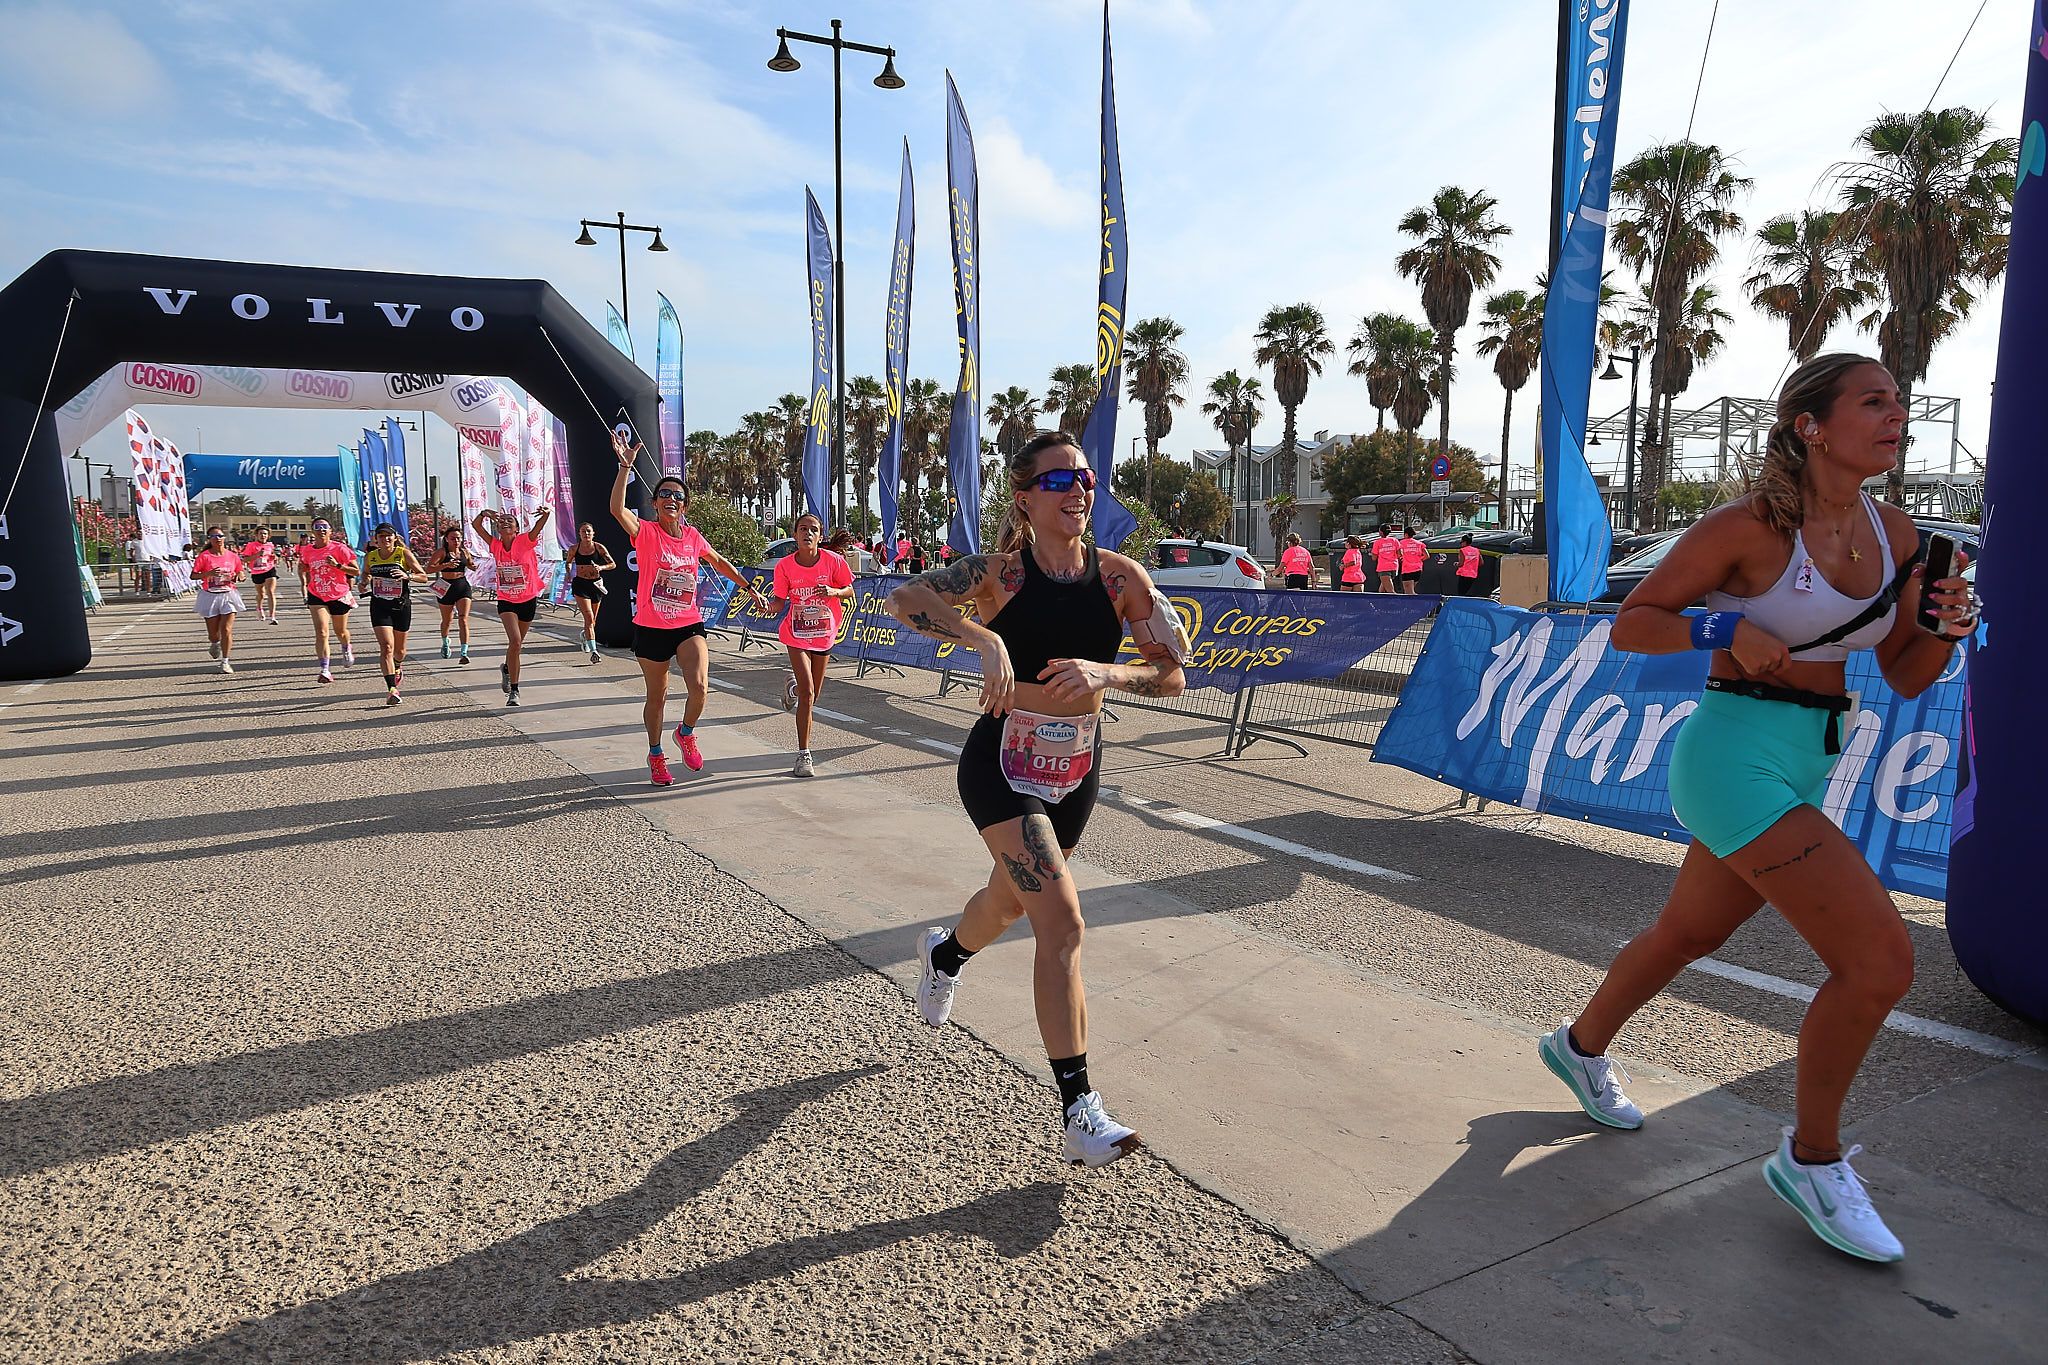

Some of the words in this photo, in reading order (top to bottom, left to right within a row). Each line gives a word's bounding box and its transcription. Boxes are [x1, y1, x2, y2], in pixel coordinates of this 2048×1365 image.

[142, 286, 485, 332] VOLVO
[131, 362, 196, 395] COSMO
[291, 370, 349, 399] COSMO
[457, 376, 499, 407] COSM
[459, 426, 501, 449] COSM
[238, 458, 306, 485] Marlene
[666, 587, 683, 596] 016
[860, 592, 892, 616] Corr
[804, 619, 820, 627] 016
[853, 619, 897, 650] Express
[1213, 608, 1326, 637] Correos
[1014, 717, 1035, 728] SUMA
[1456, 616, 1951, 832] Marne
[1032, 755, 1071, 773] 016
